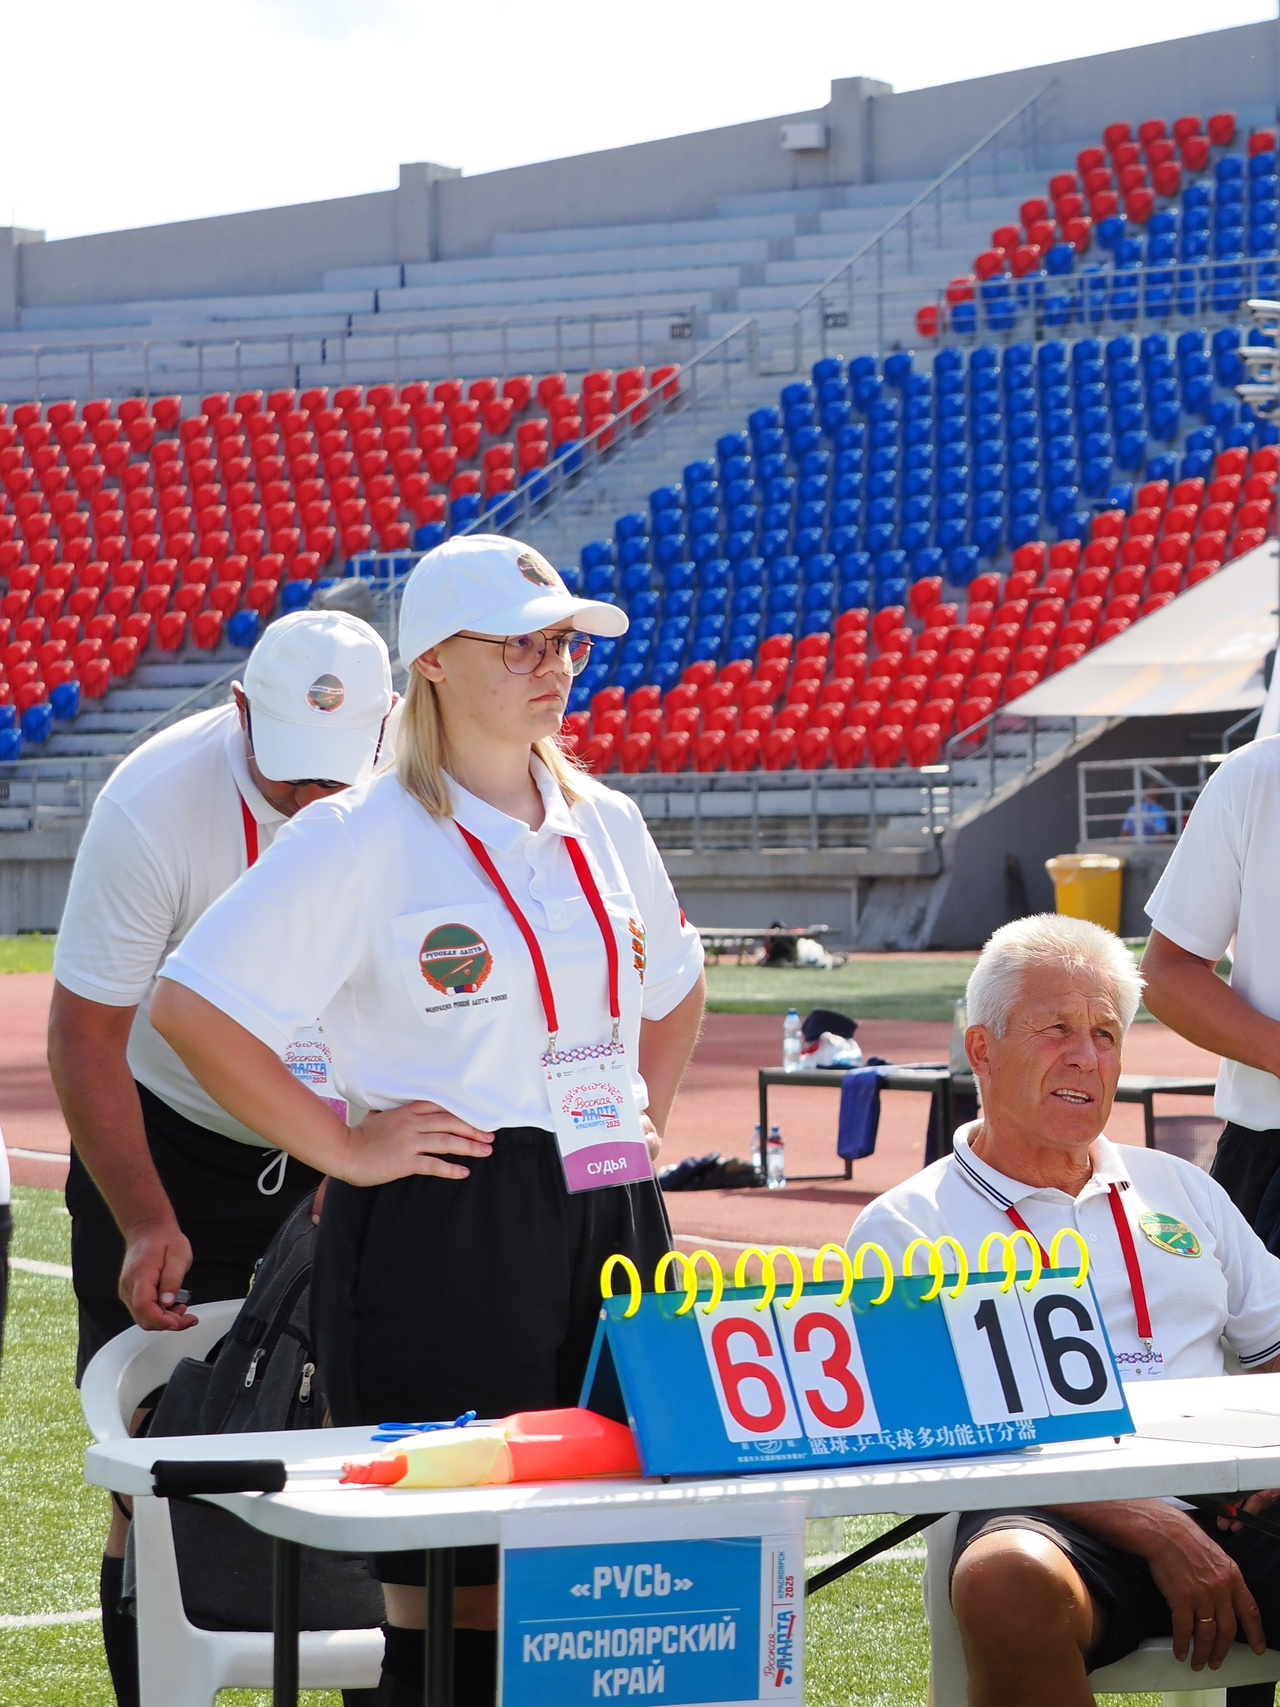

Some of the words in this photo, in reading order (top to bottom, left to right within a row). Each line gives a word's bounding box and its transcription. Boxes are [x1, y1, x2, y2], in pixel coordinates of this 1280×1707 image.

[606, 1120, 621, 1128] 2025
[587, 1157, 627, 1175] СУДЬЯ
[570, 1563, 694, 1599] «РУСЬ»
[785, 1575, 794, 1598] 2025
[523, 1615, 736, 1662] КРАСНОЯРСКИЙ
[777, 1610, 794, 1670] ЛАПТА
[593, 1659, 665, 1697] КРАЙ
